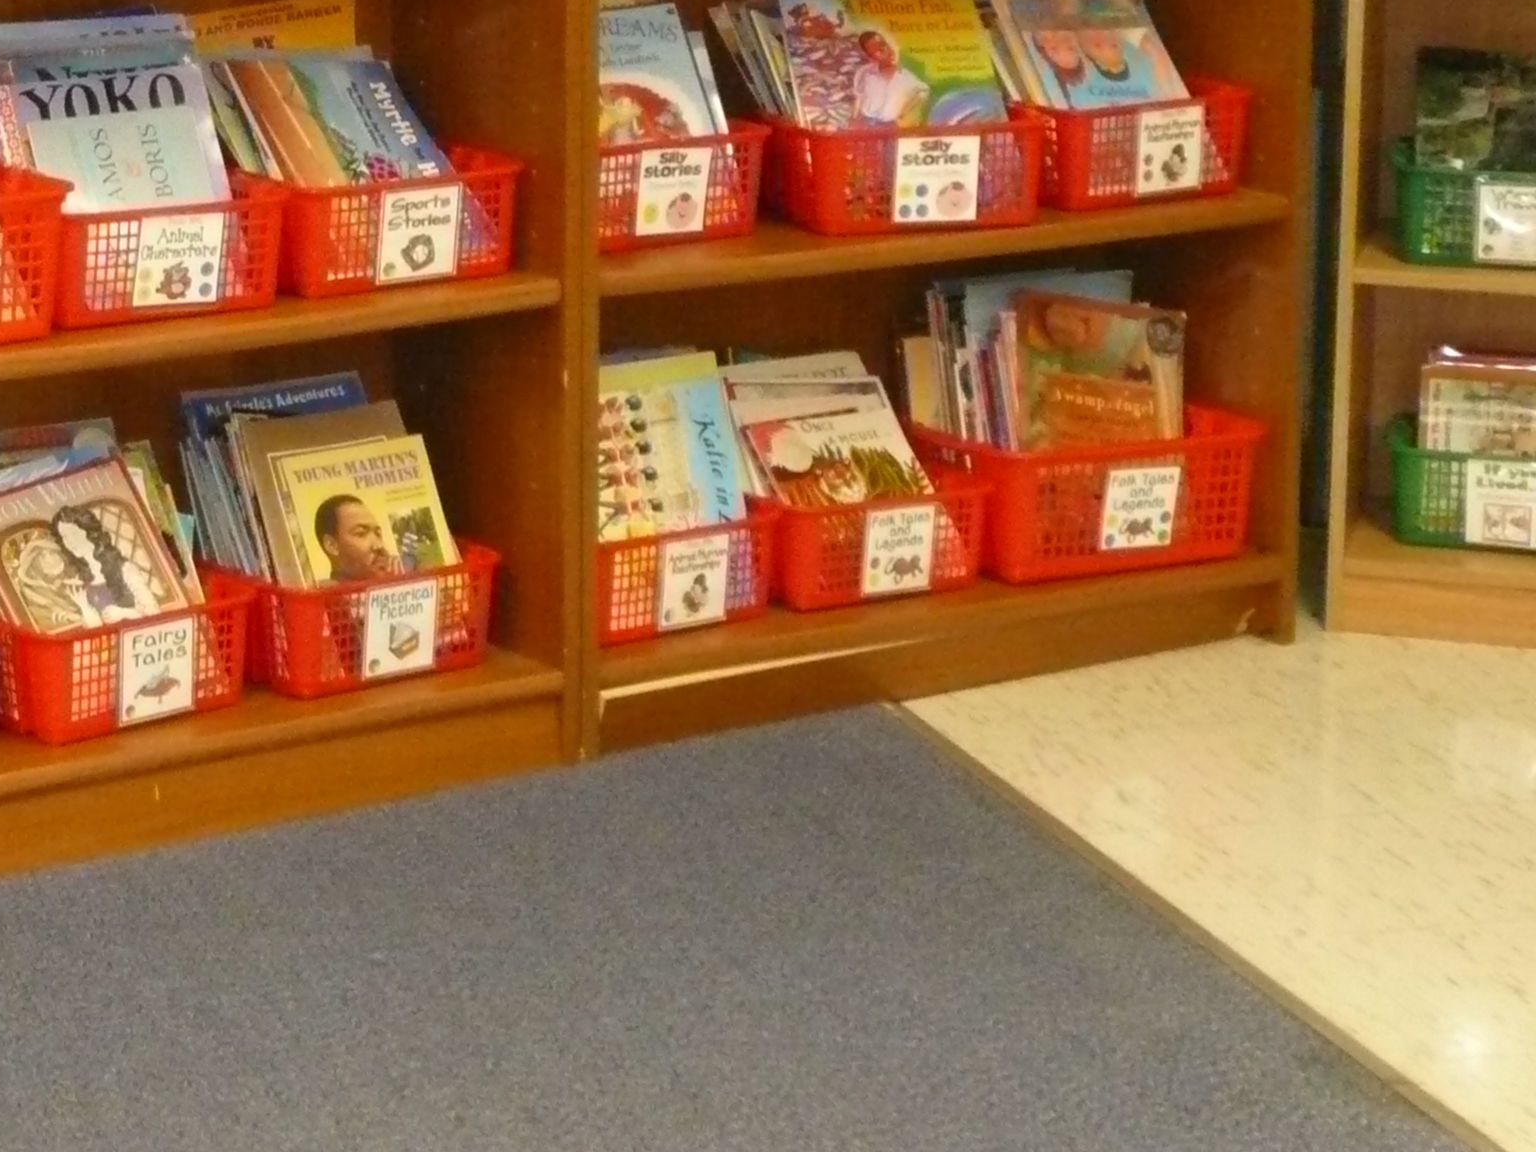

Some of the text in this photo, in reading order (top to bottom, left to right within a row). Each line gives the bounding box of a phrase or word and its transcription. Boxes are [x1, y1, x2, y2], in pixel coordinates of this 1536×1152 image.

[19, 72, 187, 121] YOKO
[368, 79, 417, 147] Myrtle
[920, 138, 954, 155] Silly
[137, 123, 174, 198] BORIS
[658, 151, 689, 166] Silly
[901, 150, 972, 167] Stories
[643, 162, 702, 179] Stories
[390, 194, 452, 215] Sports
[387, 212, 452, 231] Stories
[157, 226, 204, 245] Animal
[274, 384, 346, 408] Adventures
[291, 449, 419, 484] YOUNG MARTIN'S
[353, 467, 423, 490] PROMISE
[1140, 472, 1175, 487] Tales
[1130, 485, 1154, 499] and
[870, 511, 931, 528] Folk Tales
[889, 523, 912, 537] and
[874, 534, 924, 553] Legends
[370, 585, 434, 607] Historical
[379, 602, 423, 621] Fiction
[131, 627, 188, 651] Fairy
[131, 647, 188, 667] Tales
